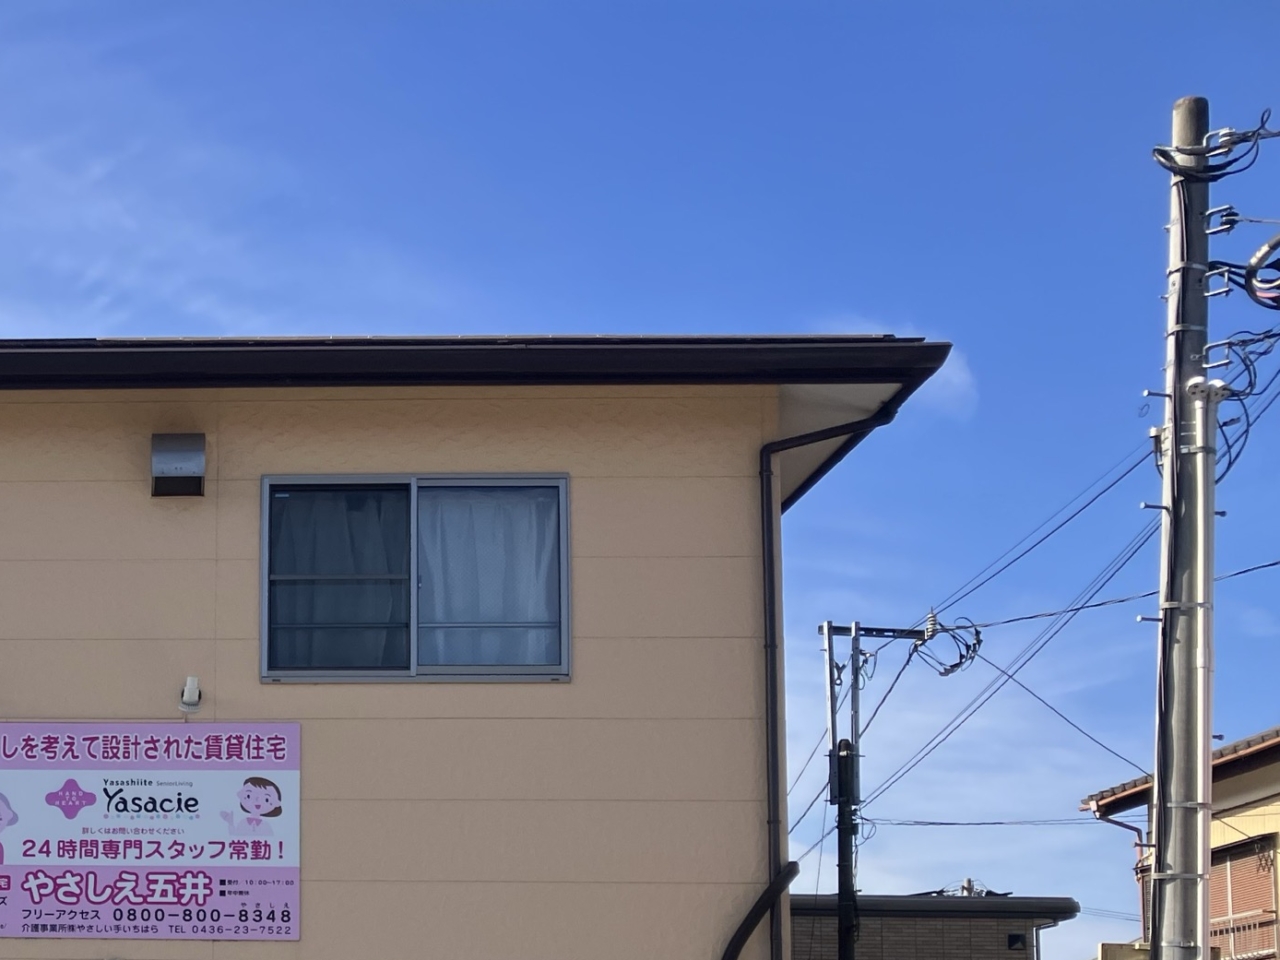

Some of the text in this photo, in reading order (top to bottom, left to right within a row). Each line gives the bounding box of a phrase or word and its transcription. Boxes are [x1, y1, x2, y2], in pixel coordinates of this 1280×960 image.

[103, 778, 153, 786] Yasashiite
[103, 787, 199, 813] Yasacie
[81, 827, 185, 835] 詳しくはお問い合わせください
[21, 870, 214, 906] やさしえ五井
[21, 908, 291, 923] フリーアクセス 0800-800-8348
[168, 925, 186, 934] TEL
[192, 925, 291, 935] 0436-23-7522
